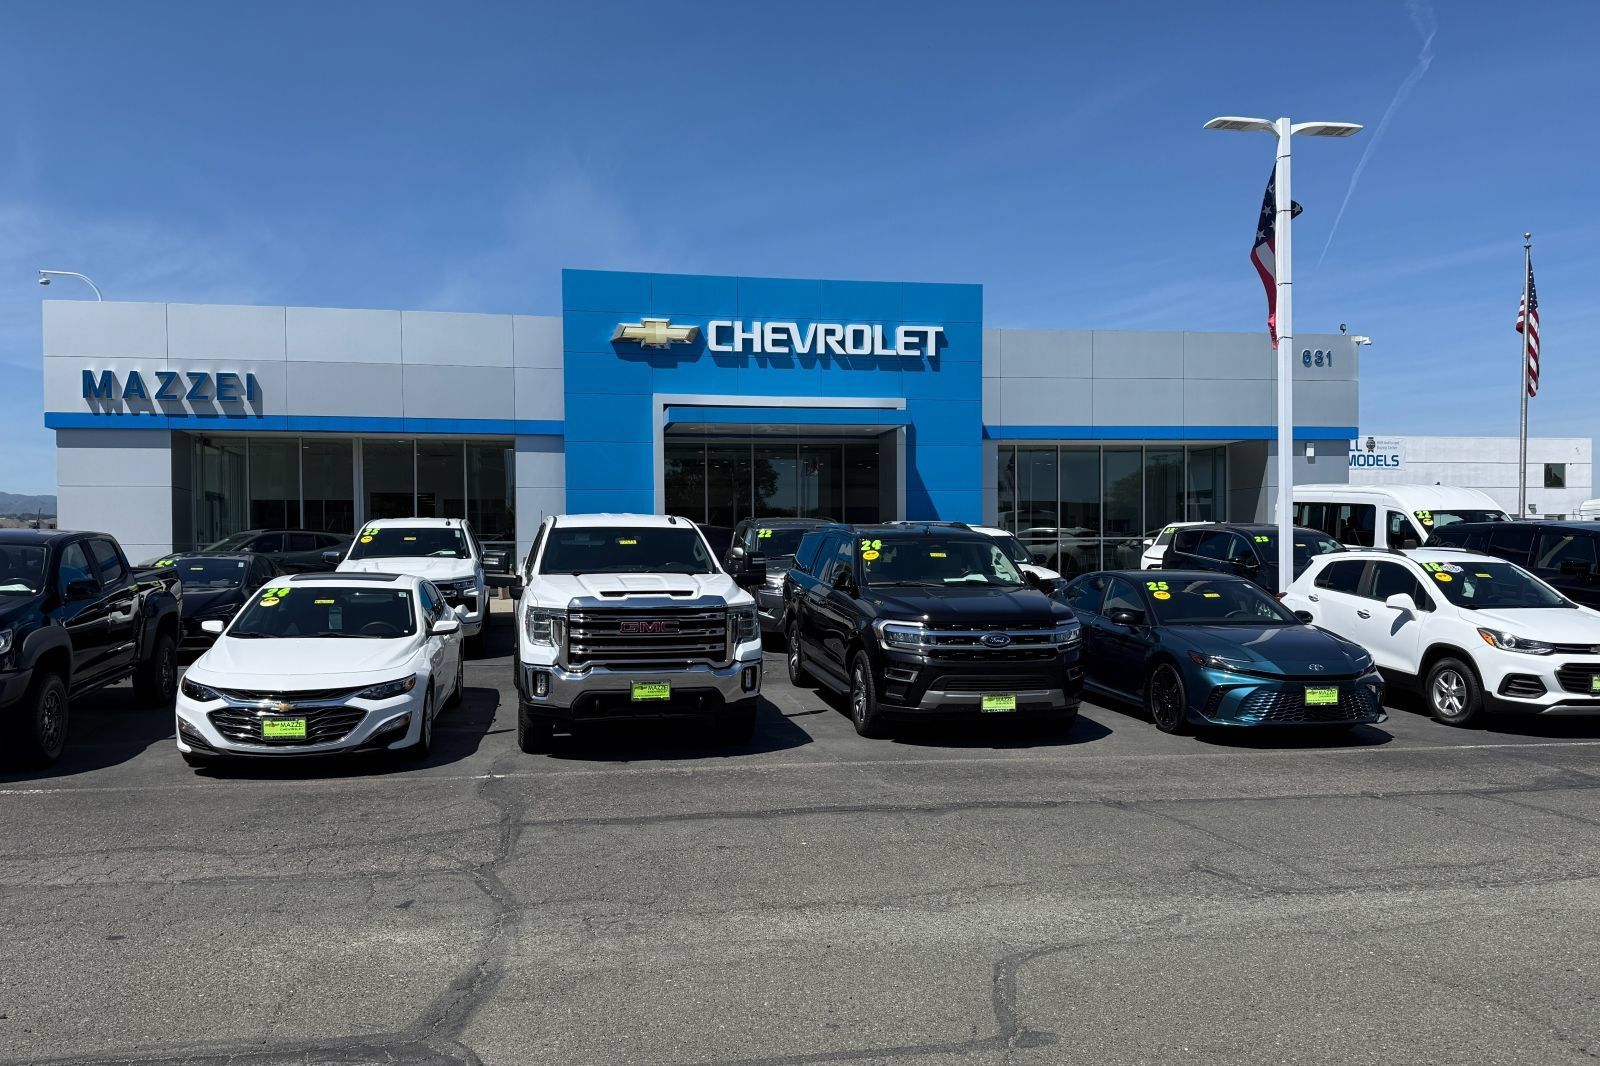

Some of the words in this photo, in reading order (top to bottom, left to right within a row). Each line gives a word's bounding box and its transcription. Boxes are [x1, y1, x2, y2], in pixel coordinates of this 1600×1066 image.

[707, 320, 944, 357] CHEVROLET
[1302, 349, 1332, 366] 631
[82, 369, 256, 401] MAZZEI
[1416, 510, 1431, 518] 22
[758, 528, 772, 538] 22
[861, 540, 881, 550] 24
[1146, 582, 1168, 590] 25
[620, 621, 680, 633] GMC
